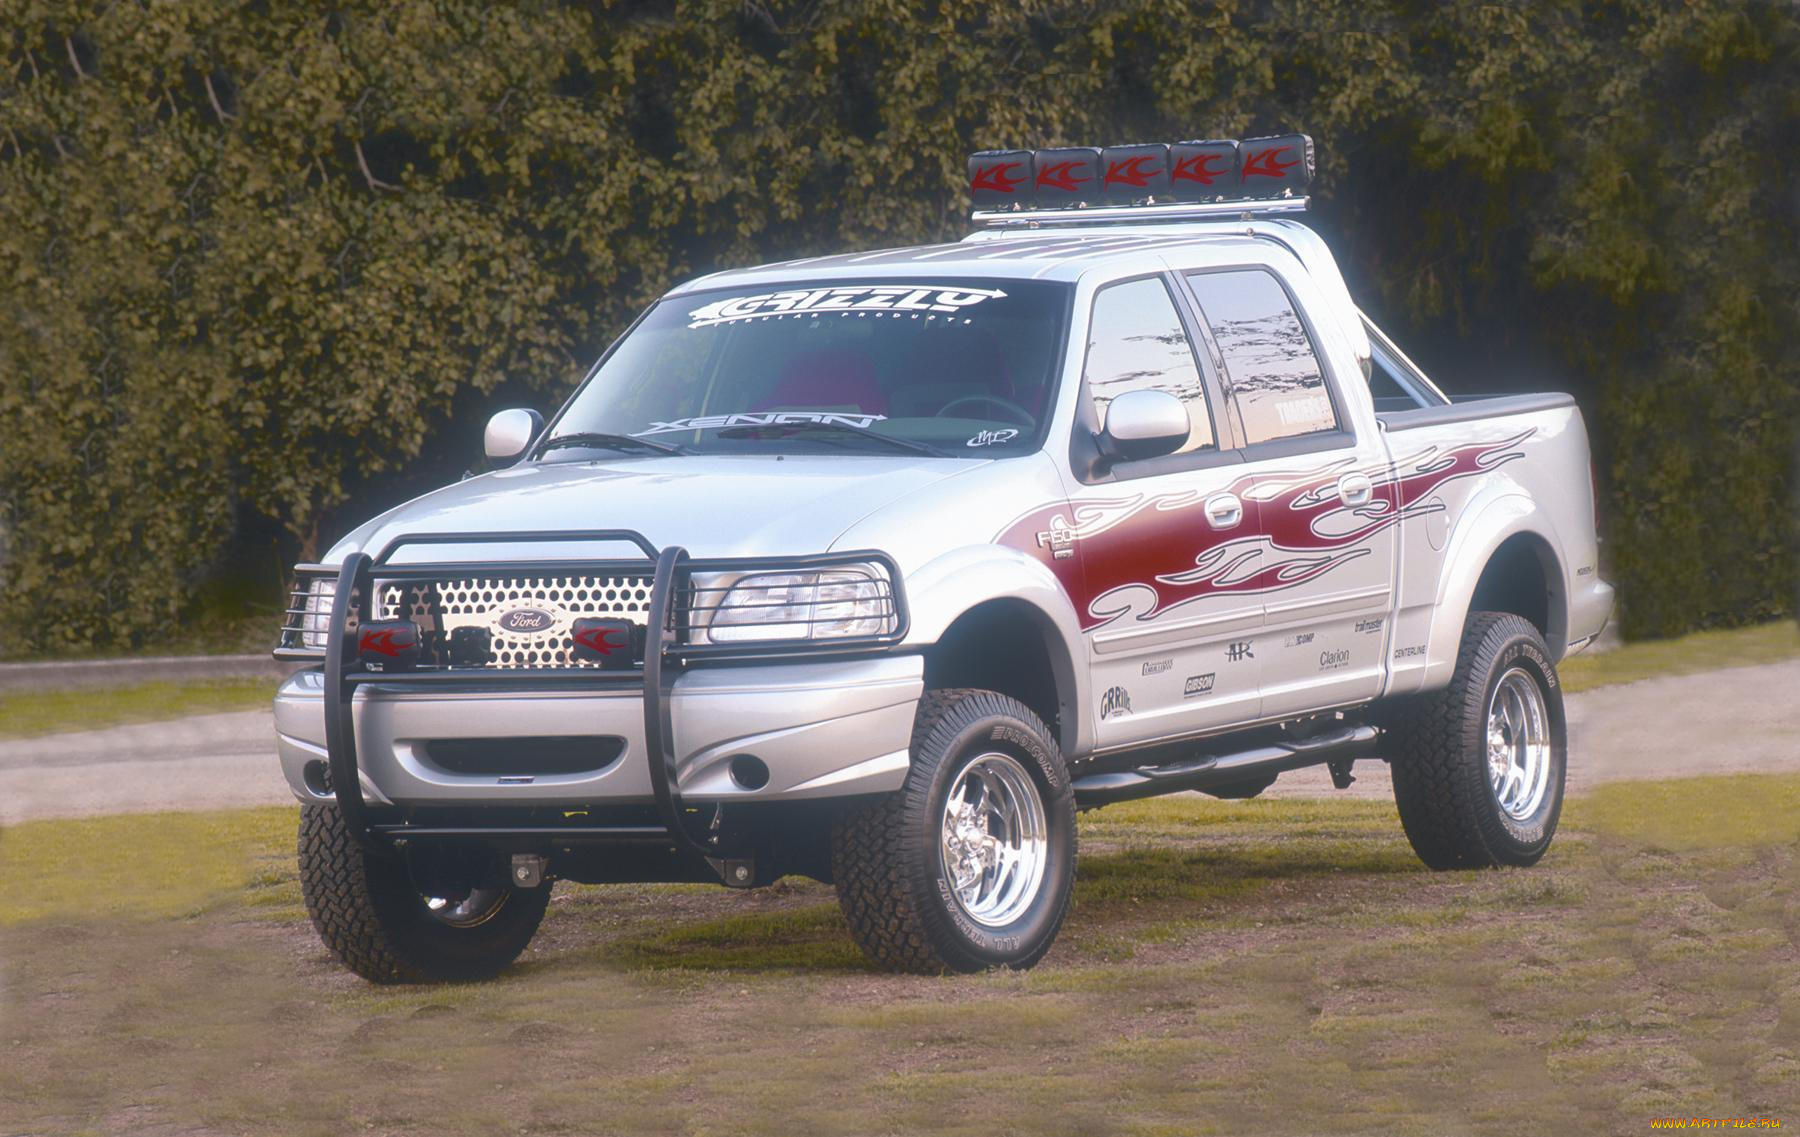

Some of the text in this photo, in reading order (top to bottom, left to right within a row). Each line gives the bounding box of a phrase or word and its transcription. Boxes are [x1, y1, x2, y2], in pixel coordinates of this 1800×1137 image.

[972, 162, 1029, 196] KC
[1037, 161, 1093, 195] KC
[1104, 156, 1162, 190] KC
[1172, 154, 1229, 189] KC
[1242, 146, 1301, 181] KC
[719, 288, 988, 317] GRIZZLY
[509, 611, 542, 628] Ford
[1320, 649, 1350, 666] Clarion
